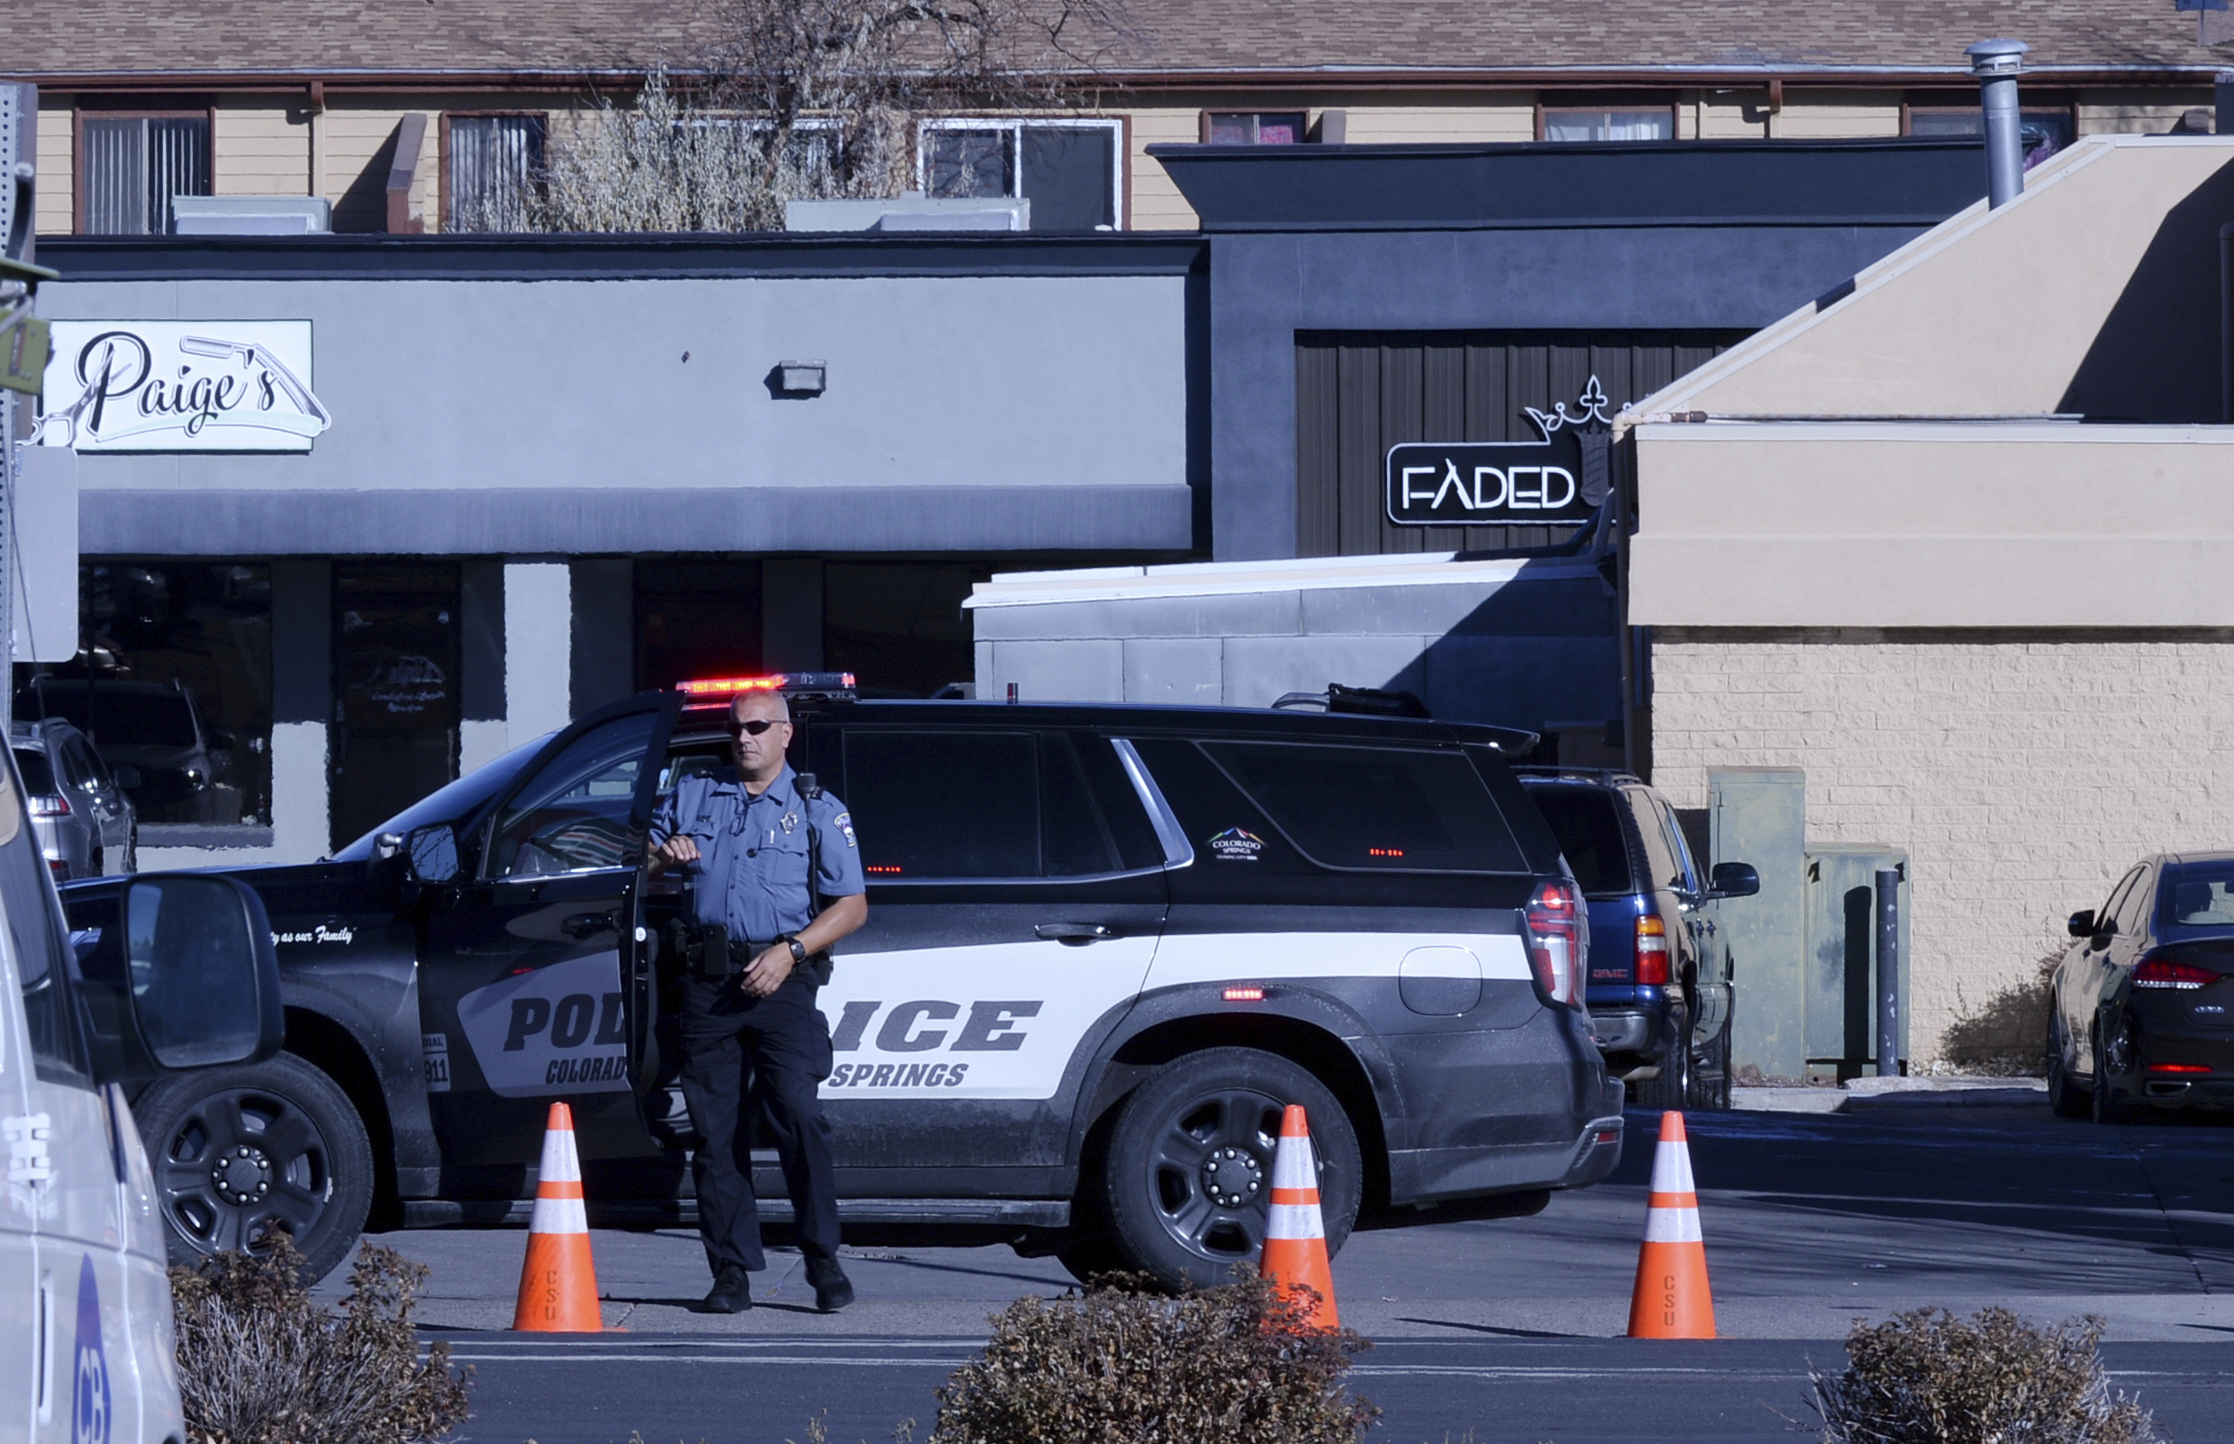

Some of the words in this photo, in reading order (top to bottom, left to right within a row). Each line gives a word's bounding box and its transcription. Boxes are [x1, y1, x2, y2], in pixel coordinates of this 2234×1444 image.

[77, 331, 276, 435] Paige's
[1402, 458, 1575, 509] FADED
[1212, 840, 1261, 850] COLORADO
[281, 932, 293, 943] as
[295, 932, 313, 942] our
[1592, 968, 1628, 979] GMC
[422, 1037, 443, 1047] DIAL
[424, 1059, 448, 1083] 911
[545, 1056, 626, 1085] COLORAD
[828, 1063, 969, 1087] SPRINGS
[545, 1270, 557, 1321] CSU
[1664, 1275, 1675, 1326] CSU
